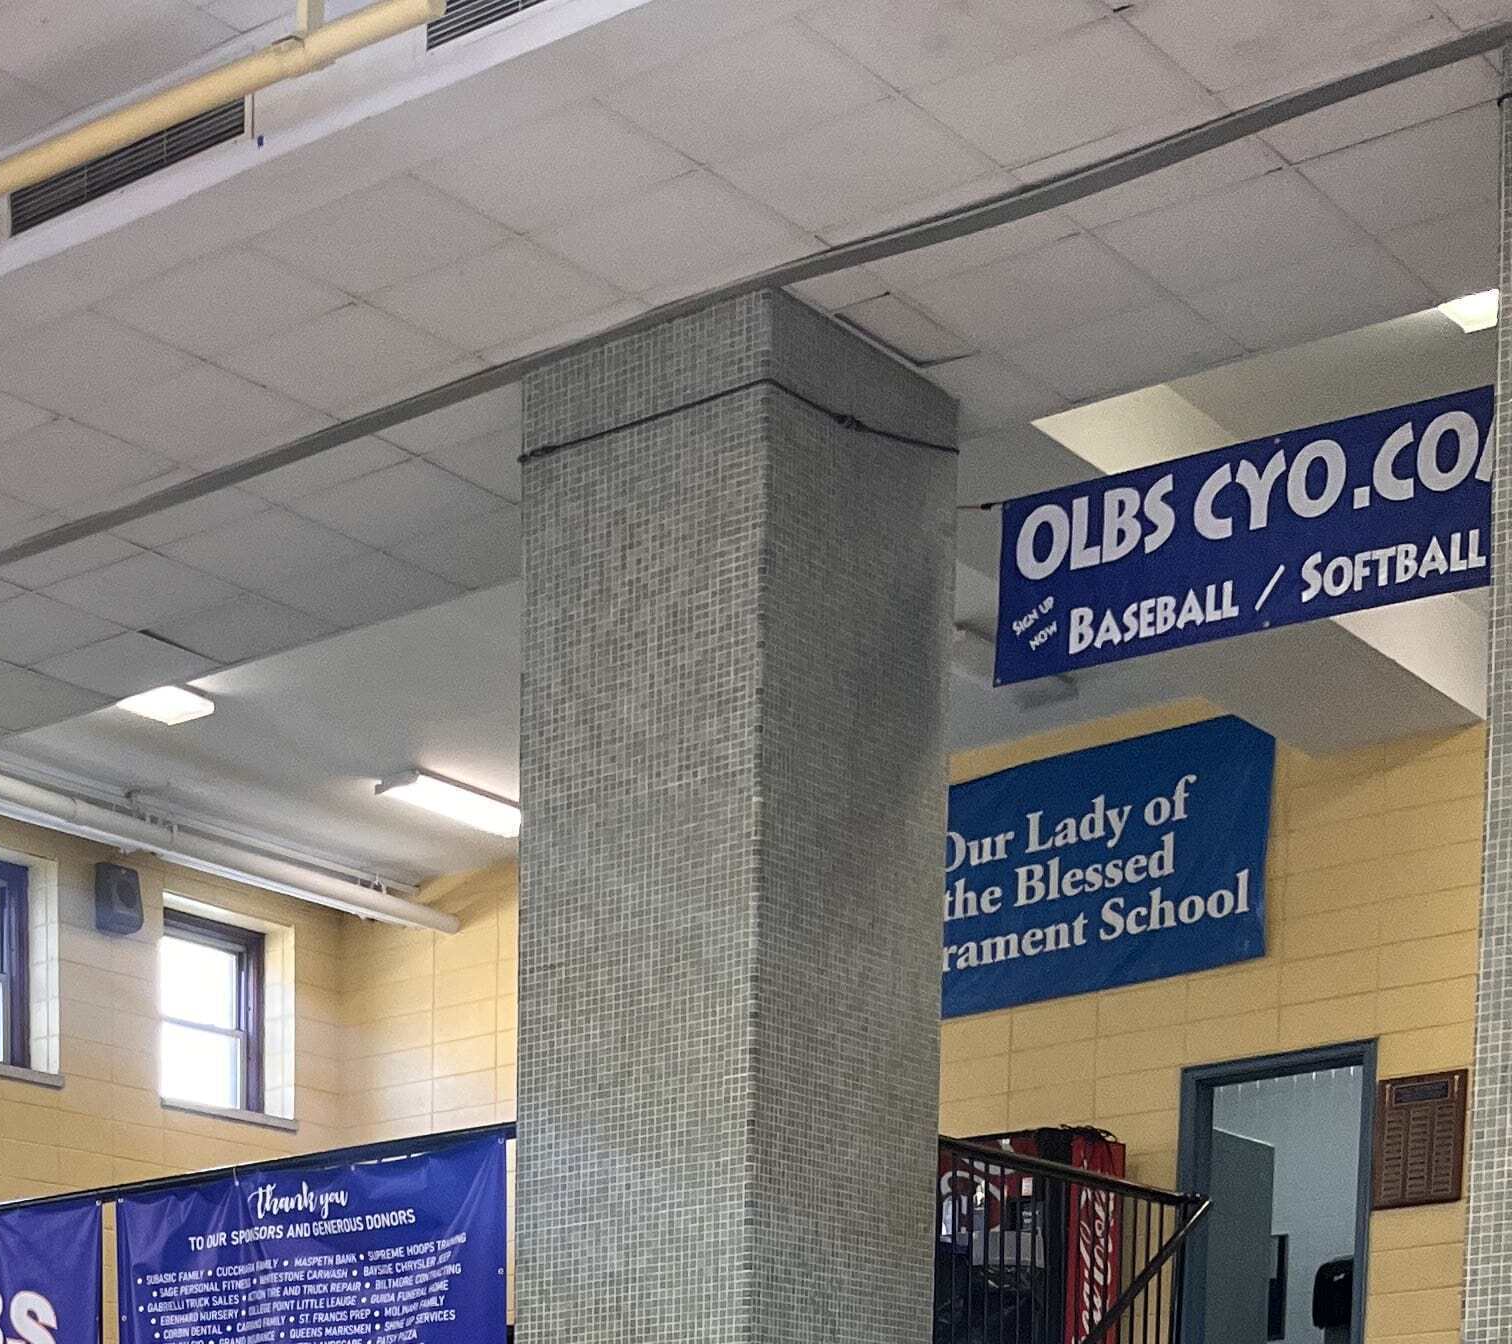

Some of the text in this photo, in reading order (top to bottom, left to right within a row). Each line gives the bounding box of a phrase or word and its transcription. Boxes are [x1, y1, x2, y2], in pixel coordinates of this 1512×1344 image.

[1015, 474, 1175, 581] OLBS
[1068, 580, 1240, 655] BASEBALL
[1301, 528, 1486, 604] SOFTBALL
[1012, 596, 1054, 636] SIGN UP
[1029, 621, 1058, 651] NOW
[1025, 794, 1132, 854] Lady
[1144, 774, 1197, 827] of
[943, 831, 1176, 922] the Blessed
[942, 868, 1250, 973] rament School
[319, 1188, 348, 1219] you
[188, 1209, 416, 1251] TO OUR SPONSORS AND GENEROUS DONORS
[178, 1270, 204, 1283] FAMILY
[294, 1254, 334, 1267] MASPETH
[335, 1253, 357, 1265] BANK
[367, 1246, 406, 1262] SUPREME
[406, 1241, 435, 1255] HOOPS
[179, 1282, 220, 1296] PERSONAL
[306, 1270, 348, 1282] CARWASH
[363, 1263, 393, 1277] BAYSIDE
[395, 1256, 436, 1273] CHRYSLER
[186, 1297, 210, 1310] TRUCK
[212, 1294, 239, 1306] SALES
[282, 1284, 301, 1296] AND
[303, 1282, 329, 1295] TRUCK
[330, 1281, 361, 1293] REPAIR
[375, 1276, 414, 1290] BILTMORE
[199, 1309, 238, 1322] NURSERY
[297, 1297, 325, 1310] LITTLE
[190, 1324, 223, 1337] DENTAL
[312, 1310, 349, 1324] FRANCIS
[349, 1307, 371, 1320] PREP
[290, 1325, 322, 1339] QUEENS
[323, 1323, 372, 1337] MARKSMEN
[415, 1309, 456, 1325] SERVICES
